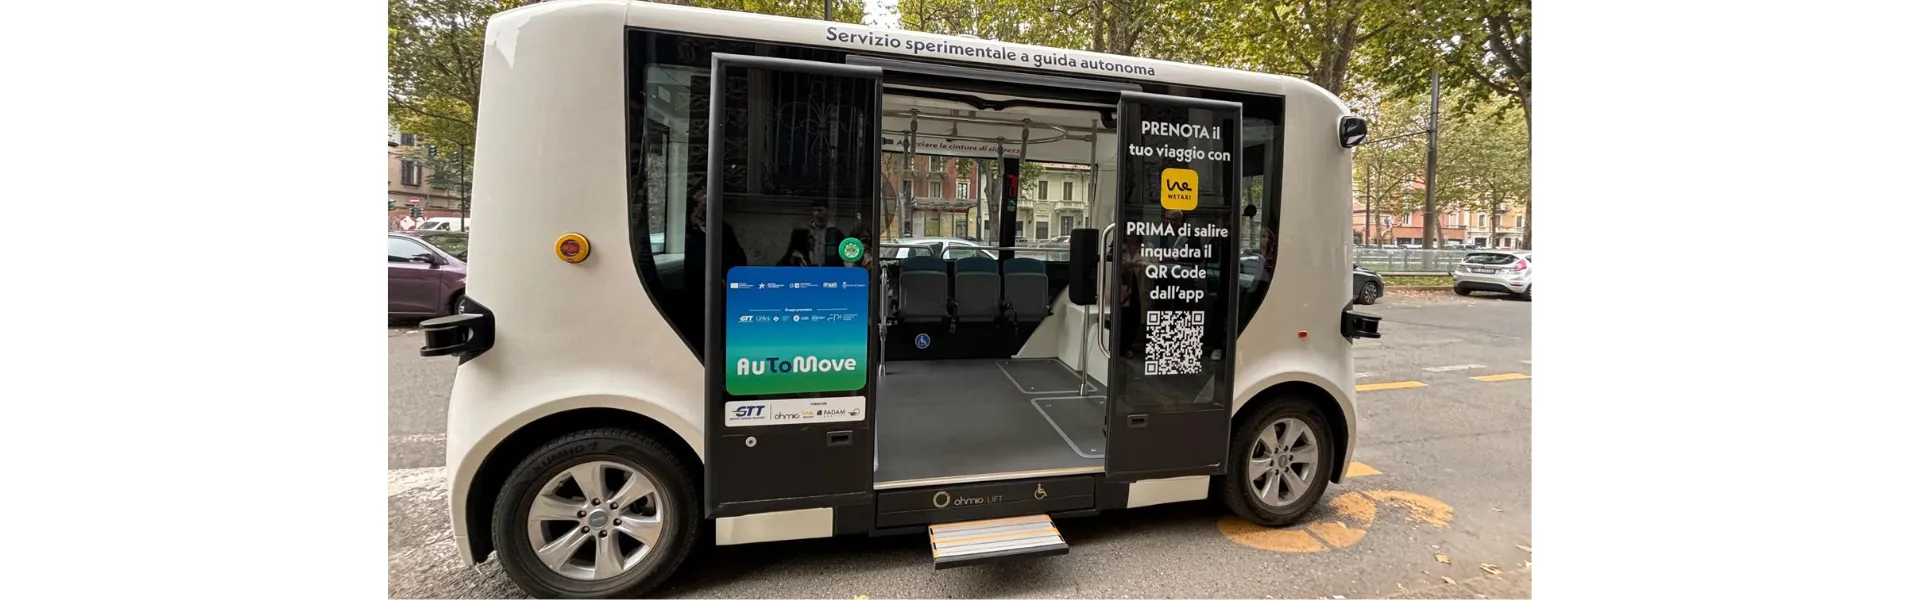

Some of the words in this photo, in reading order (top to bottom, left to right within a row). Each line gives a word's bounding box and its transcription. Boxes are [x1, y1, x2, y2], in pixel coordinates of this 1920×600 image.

[826, 27, 901, 48] Servizio
[905, 40, 1017, 61] sperimentale
[1020, 53, 1029, 62] a
[1033, 53, 1077, 67] guida
[1081, 59, 1155, 76] autonoma
[1141, 121, 1210, 139] PRENOTA
[1212, 126, 1221, 140] il
[948, 143, 977, 151] cintura
[1129, 143, 1153, 156] tuo
[1156, 144, 1205, 162] viaggio
[1208, 150, 1231, 162] con
[1126, 221, 1175, 236] PRIMA
[1178, 223, 1191, 237] di
[1194, 223, 1228, 238] salire
[1140, 244, 1201, 261] inquadra
[1204, 244, 1212, 258] il
[1145, 264, 1167, 280] QR
[1171, 265, 1207, 279] Code
[1149, 285, 1204, 303] dall'app
[737, 355, 857, 375] AuToMove
[954, 496, 984, 506] ohmio
[987, 495, 1003, 503] LIFT
